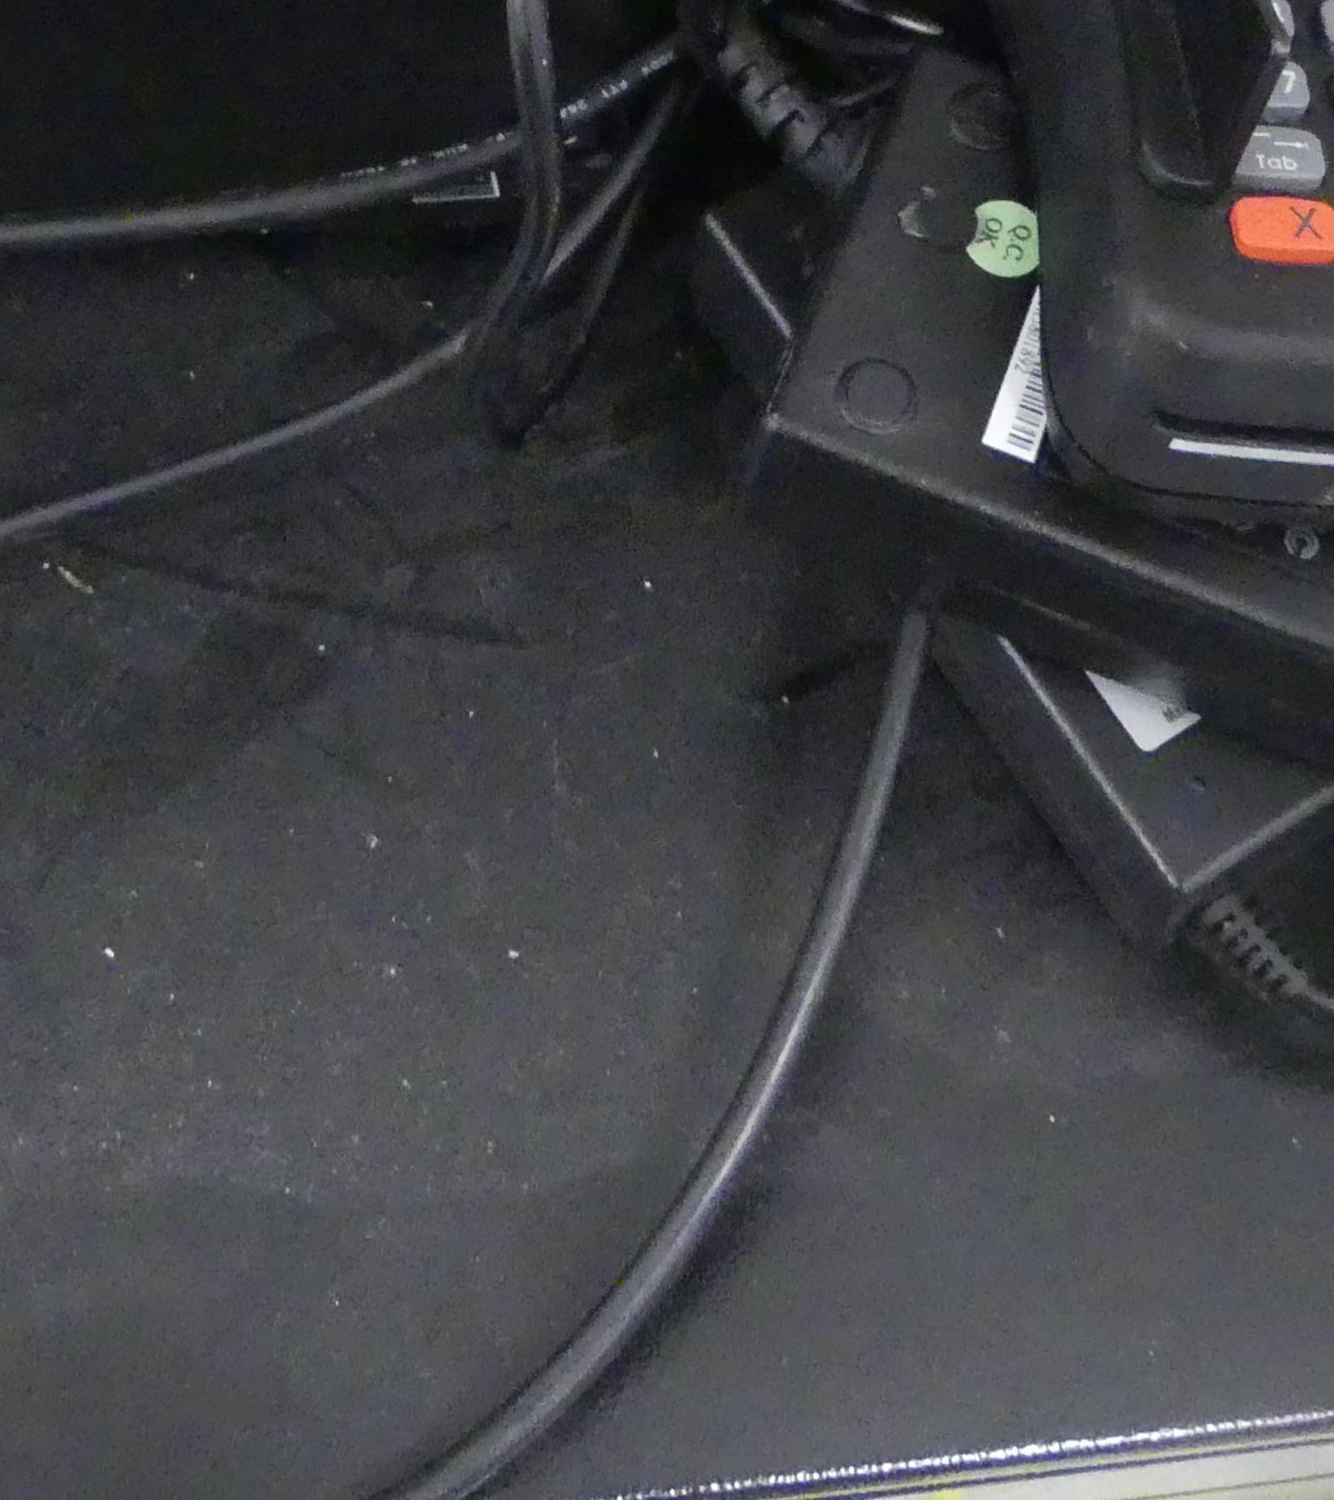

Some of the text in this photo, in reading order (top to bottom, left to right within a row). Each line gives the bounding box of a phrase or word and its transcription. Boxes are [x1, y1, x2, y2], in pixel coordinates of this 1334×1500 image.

[1281, 69, 1296, 94] 7
[1255, 153, 1298, 172] Tab
[978, 216, 1003, 248] OK
